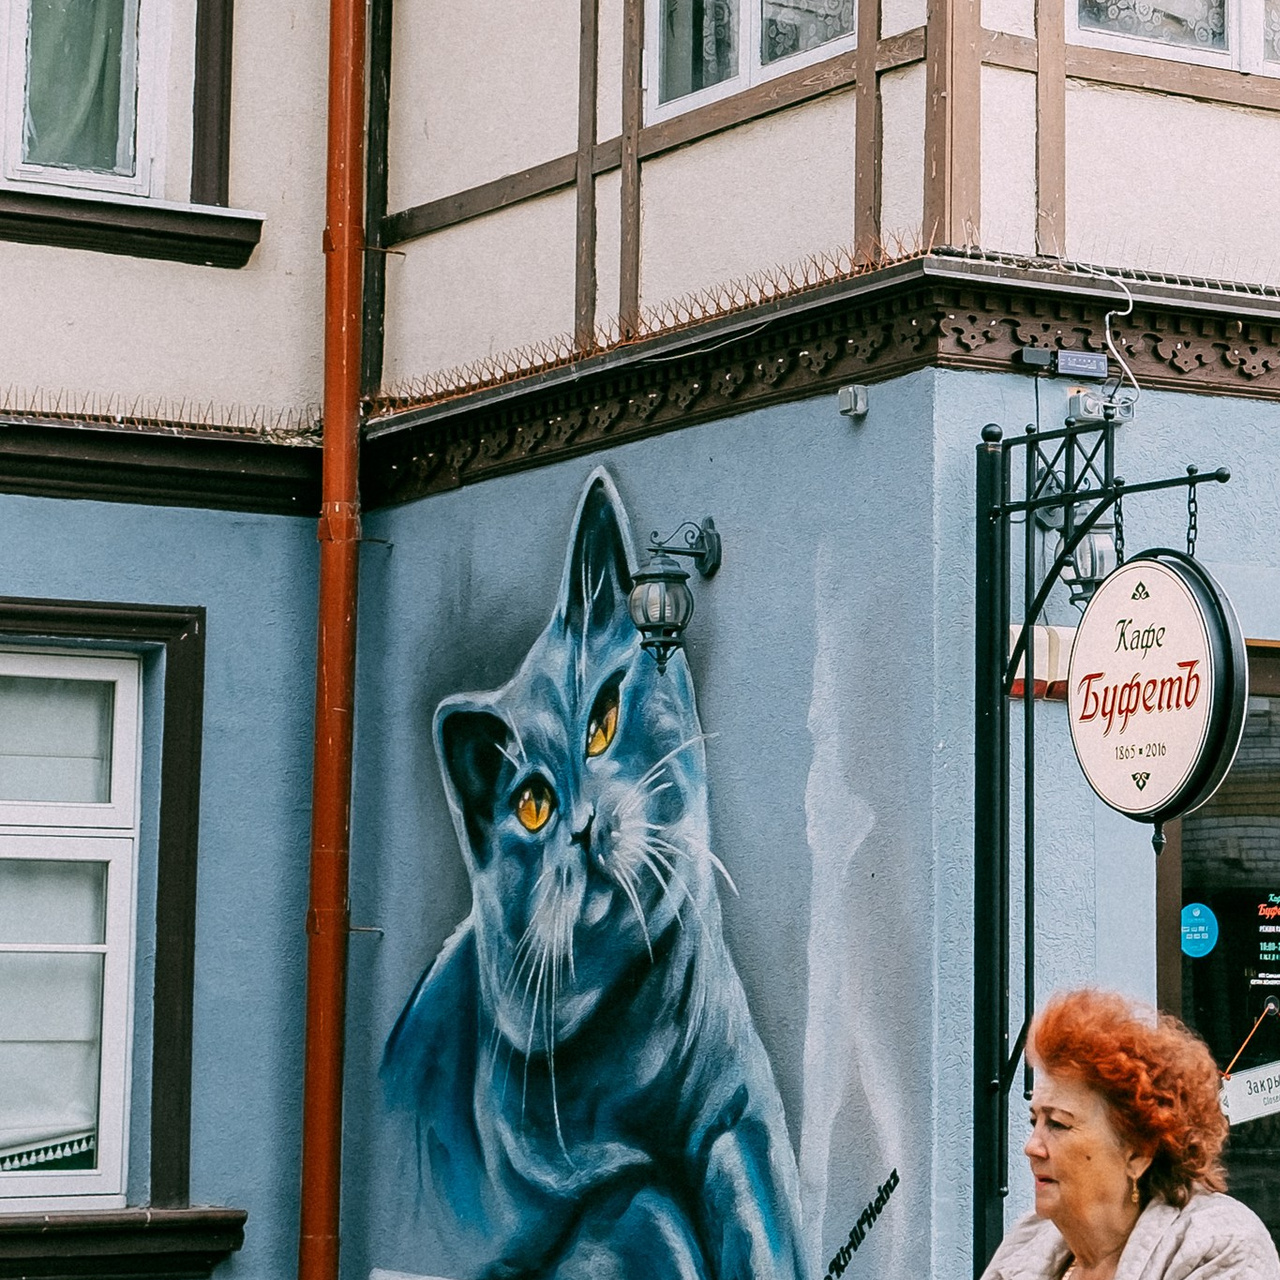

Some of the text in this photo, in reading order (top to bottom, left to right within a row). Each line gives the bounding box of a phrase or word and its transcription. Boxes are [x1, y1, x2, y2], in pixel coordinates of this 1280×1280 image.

[1114, 618, 1166, 660] Кафе
[1077, 660, 1201, 738] Буфетъ
[1115, 742, 1167, 760] 1865 2016
